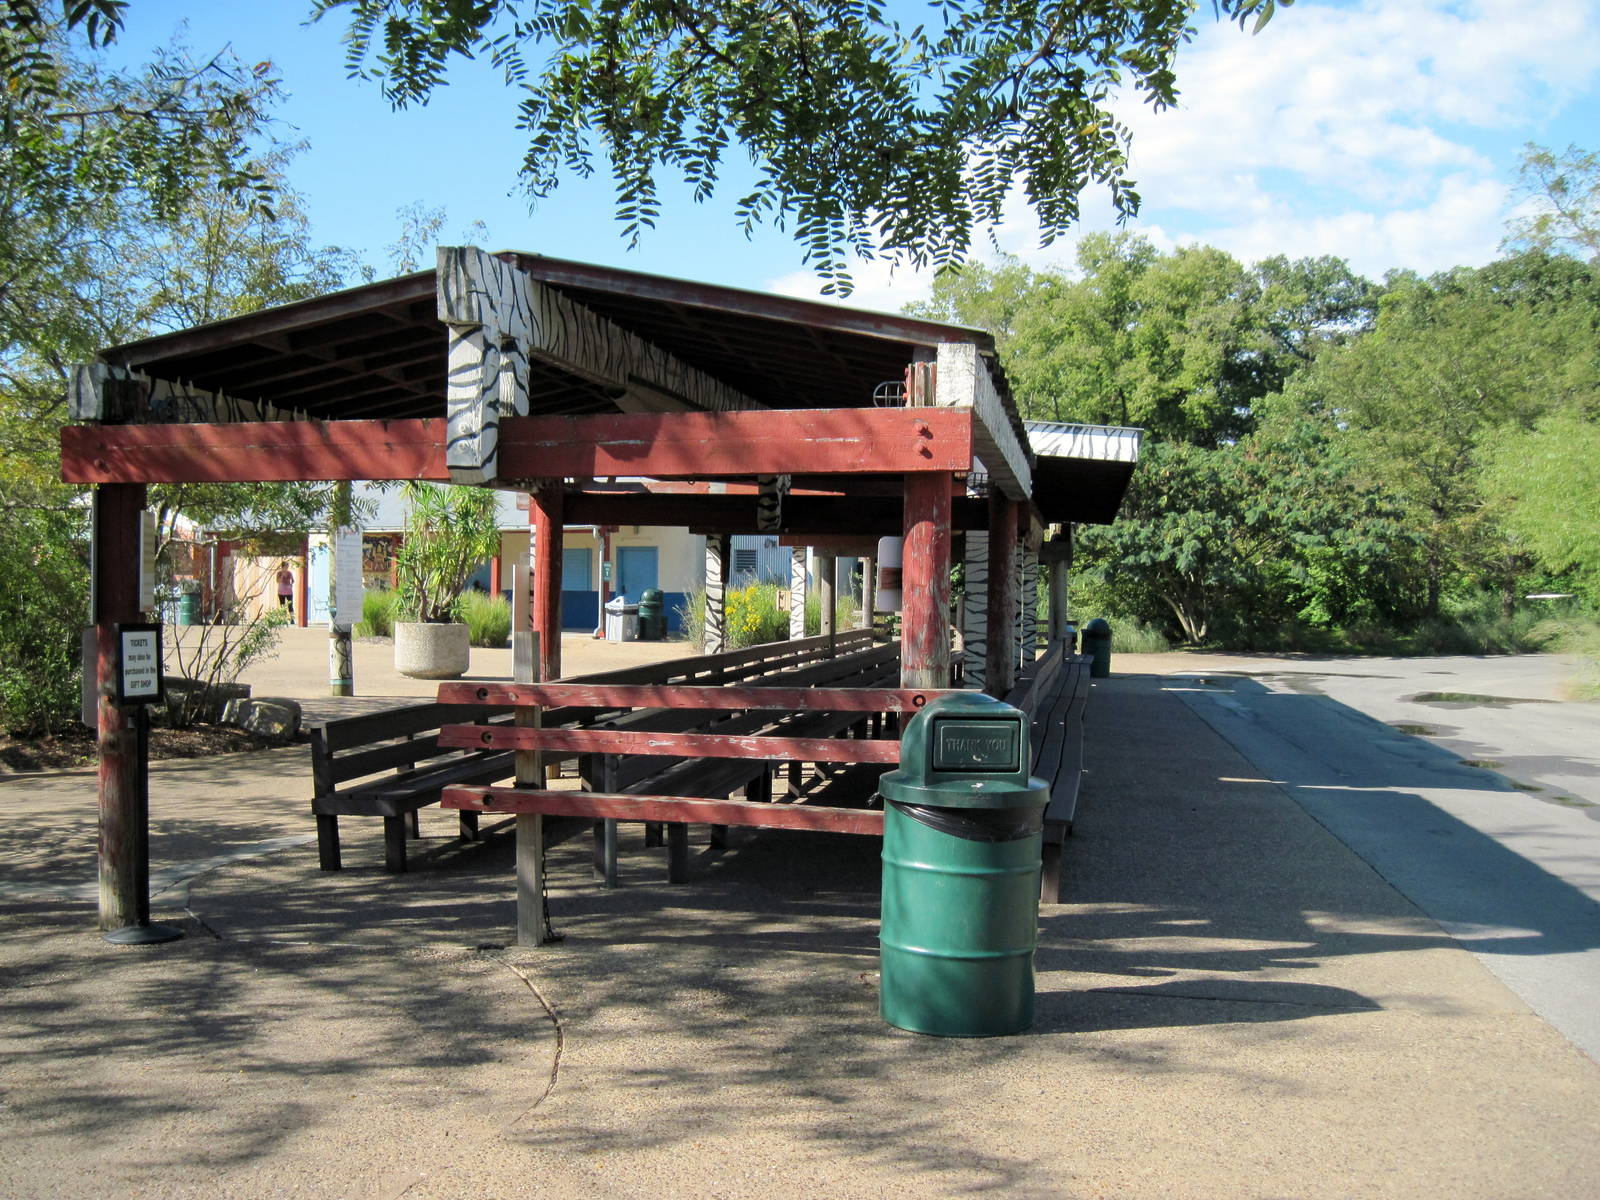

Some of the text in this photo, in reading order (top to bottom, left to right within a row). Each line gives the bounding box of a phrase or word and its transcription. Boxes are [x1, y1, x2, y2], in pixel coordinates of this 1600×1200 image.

[130, 639, 148, 647] TICKETS
[128, 655, 136, 663] may
[130, 680, 152, 689] GIFT SHOP
[946, 737, 1008, 752] THANK YOU
